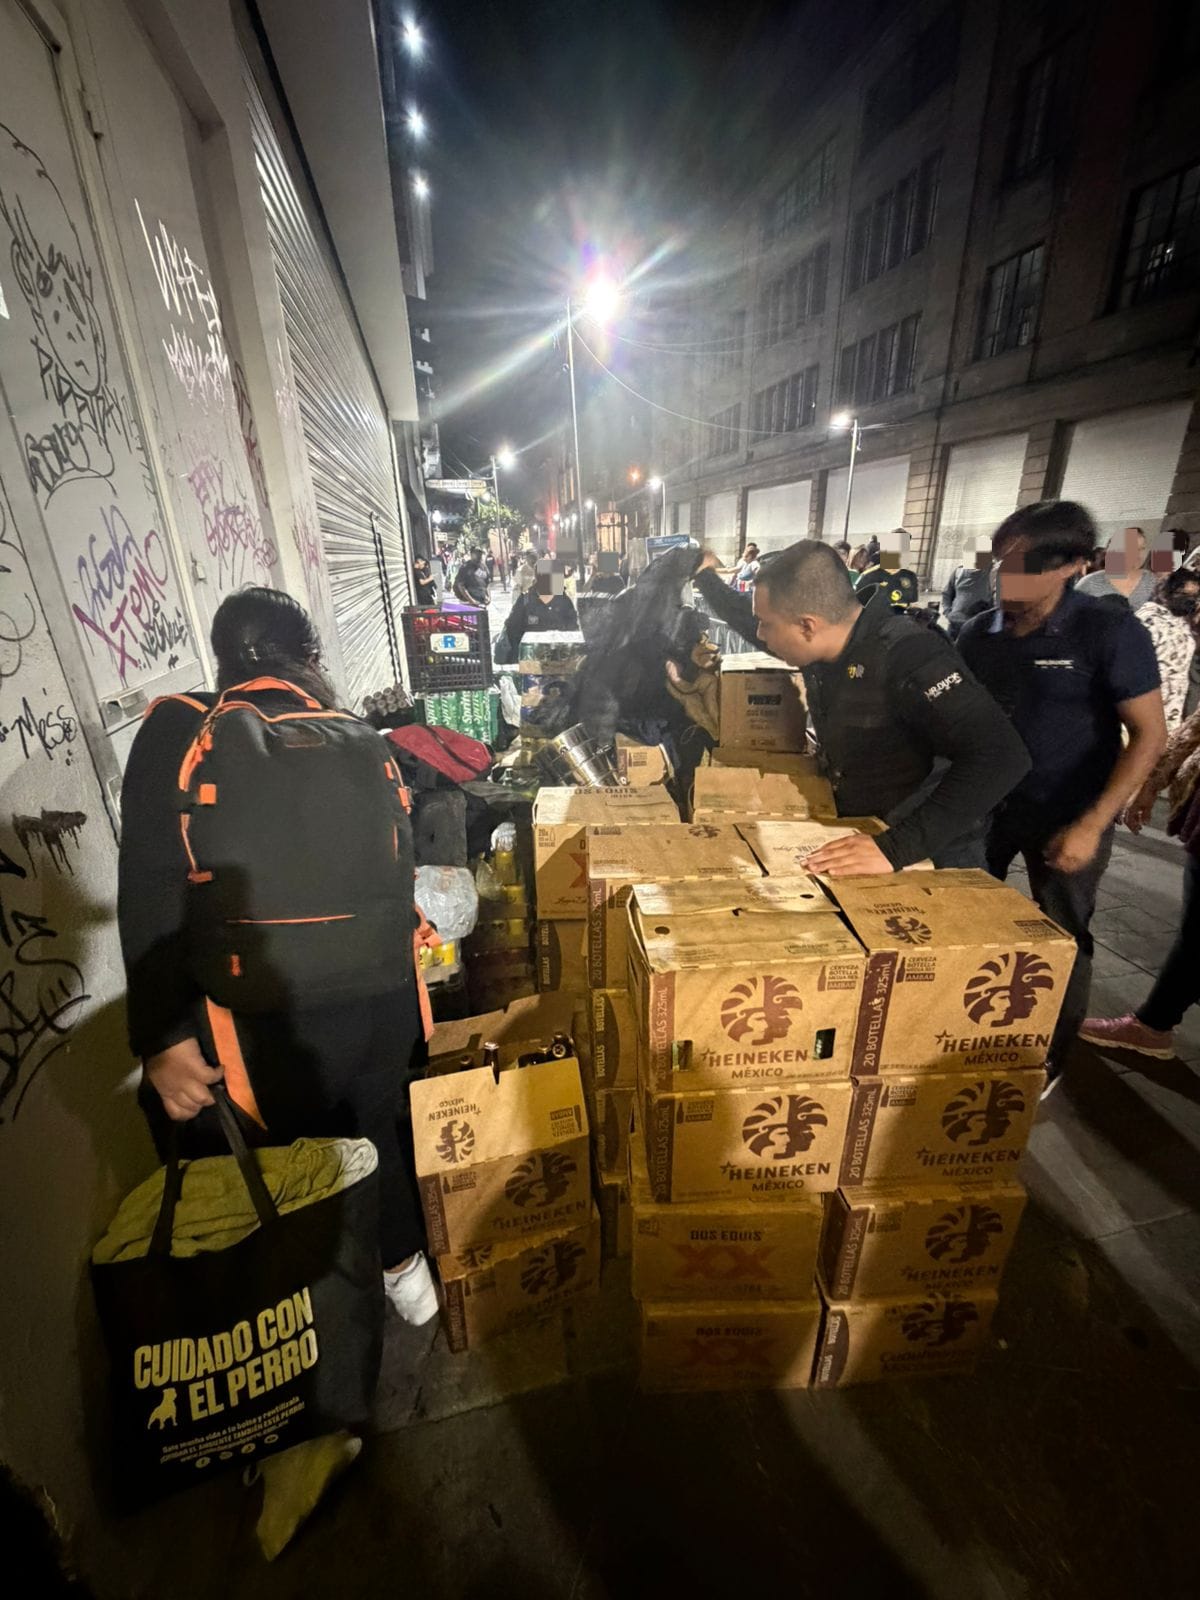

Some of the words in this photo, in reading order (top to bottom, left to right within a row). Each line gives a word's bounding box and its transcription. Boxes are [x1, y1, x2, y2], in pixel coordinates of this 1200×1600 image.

[591, 919, 603, 966] BOTELLAS
[875, 960, 892, 995] 325mL
[864, 997, 886, 1055] BOTELLAS
[655, 1020, 668, 1067] BOTELLAS
[942, 1033, 1051, 1054] HEINEKEN
[708, 1049, 808, 1068] HEINEKEN
[863, 1055, 875, 1067] 20
[964, 1050, 1019, 1066] MÉXICO
[731, 1067, 784, 1080] MÉXICO
[428, 1103, 477, 1121] HEINEKEN
[861, 1087, 878, 1118] 325mL
[851, 1119, 871, 1167] BOTELLAS
[656, 1135, 669, 1185] BOTELLAS
[922, 1149, 1021, 1167] HEINEKEN
[729, 1162, 831, 1181] HEINEKEN
[848, 1168, 861, 1179] 20
[751, 1179, 805, 1193] MÉXICO
[690, 1230, 717, 1241] DOS
[720, 1230, 762, 1242] EQUIS
[906, 1265, 1000, 1282] HEINEKEN
[134, 1320, 254, 1390] CUIDADO
[257, 1286, 314, 1350] CON
[188, 1381, 226, 1422] EL
[227, 1328, 320, 1407] PERRO
